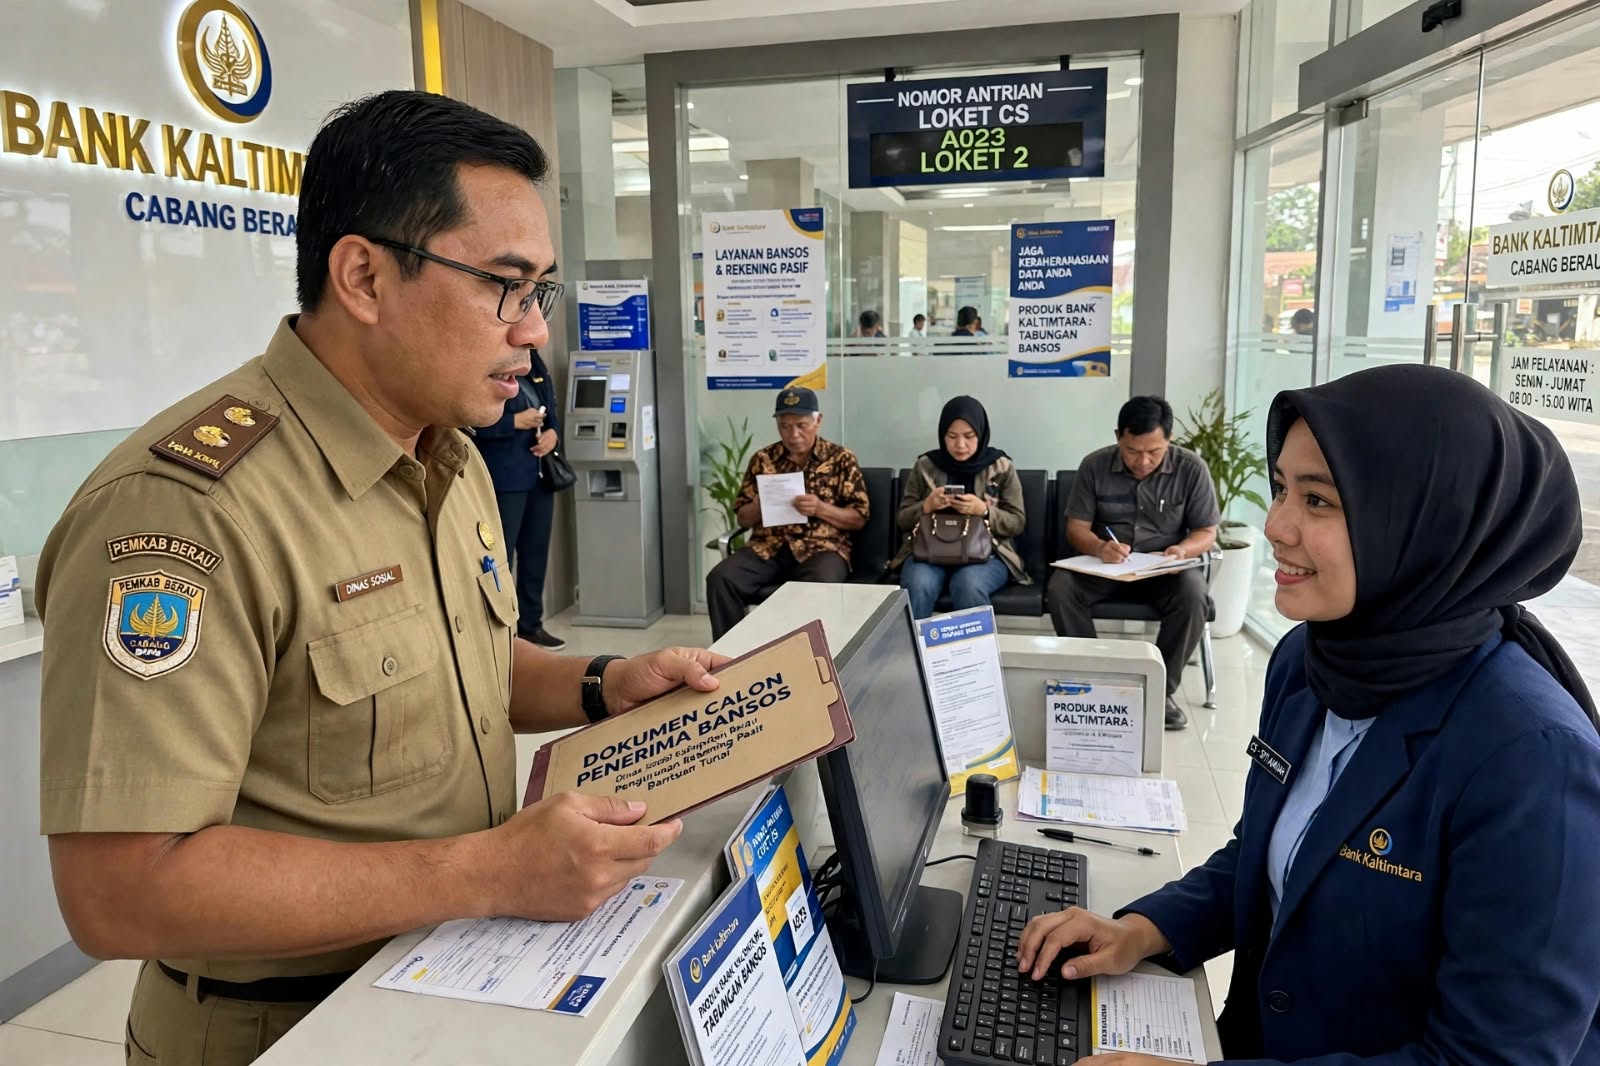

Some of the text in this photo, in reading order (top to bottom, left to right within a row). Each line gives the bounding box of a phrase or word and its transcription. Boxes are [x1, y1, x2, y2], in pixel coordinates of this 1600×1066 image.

[898, 82, 1044, 108] NOMOR ANTRIAN
[919, 103, 1030, 129] LOKET CS
[1, 90, 308, 197] BANK KALTIM
[941, 127, 1006, 149] A023
[920, 146, 1029, 173] LOKET 2
[125, 191, 235, 231] CABANG
[1018, 246, 1044, 256] JAGA
[1493, 231, 1529, 256] BANK
[715, 246, 810, 261] LAYANAN BANSOS
[715, 262, 809, 276] & REKENING PASIF
[1018, 268, 1073, 279] DATA ANDA
[1511, 257, 1558, 276] CABANG
[1018, 280, 1045, 291] ANDA
[1018, 303, 1097, 315] PRODUK BANK
[1018, 316, 1087, 328] KALTIMTARA
[1018, 330, 1078, 340] TABUNGAN
[1018, 343, 1061, 353] BANSOS
[1511, 356, 1529, 370] JAM
[1515, 374, 1543, 389] SENIN
[1550, 377, 1586, 393] JUMAT
[1567, 396, 1594, 413] WITA
[112, 536, 217, 568] PEMKAB BERAU
[118, 577, 199, 598] PEMKAB BERAU
[346, 570, 396, 595] DINAS SOSIAL
[1054, 702, 1129, 715] PRODUK BANK
[582, 709, 698, 769] DOKUMEN
[704, 672, 784, 716] CALON
[1055, 713, 1129, 727] KALTIMTARA
[576, 729, 691, 788] PENERIMA
[698, 685, 792, 737] BANSOS
[1339, 843, 1423, 883] Bank Kaltimtara
